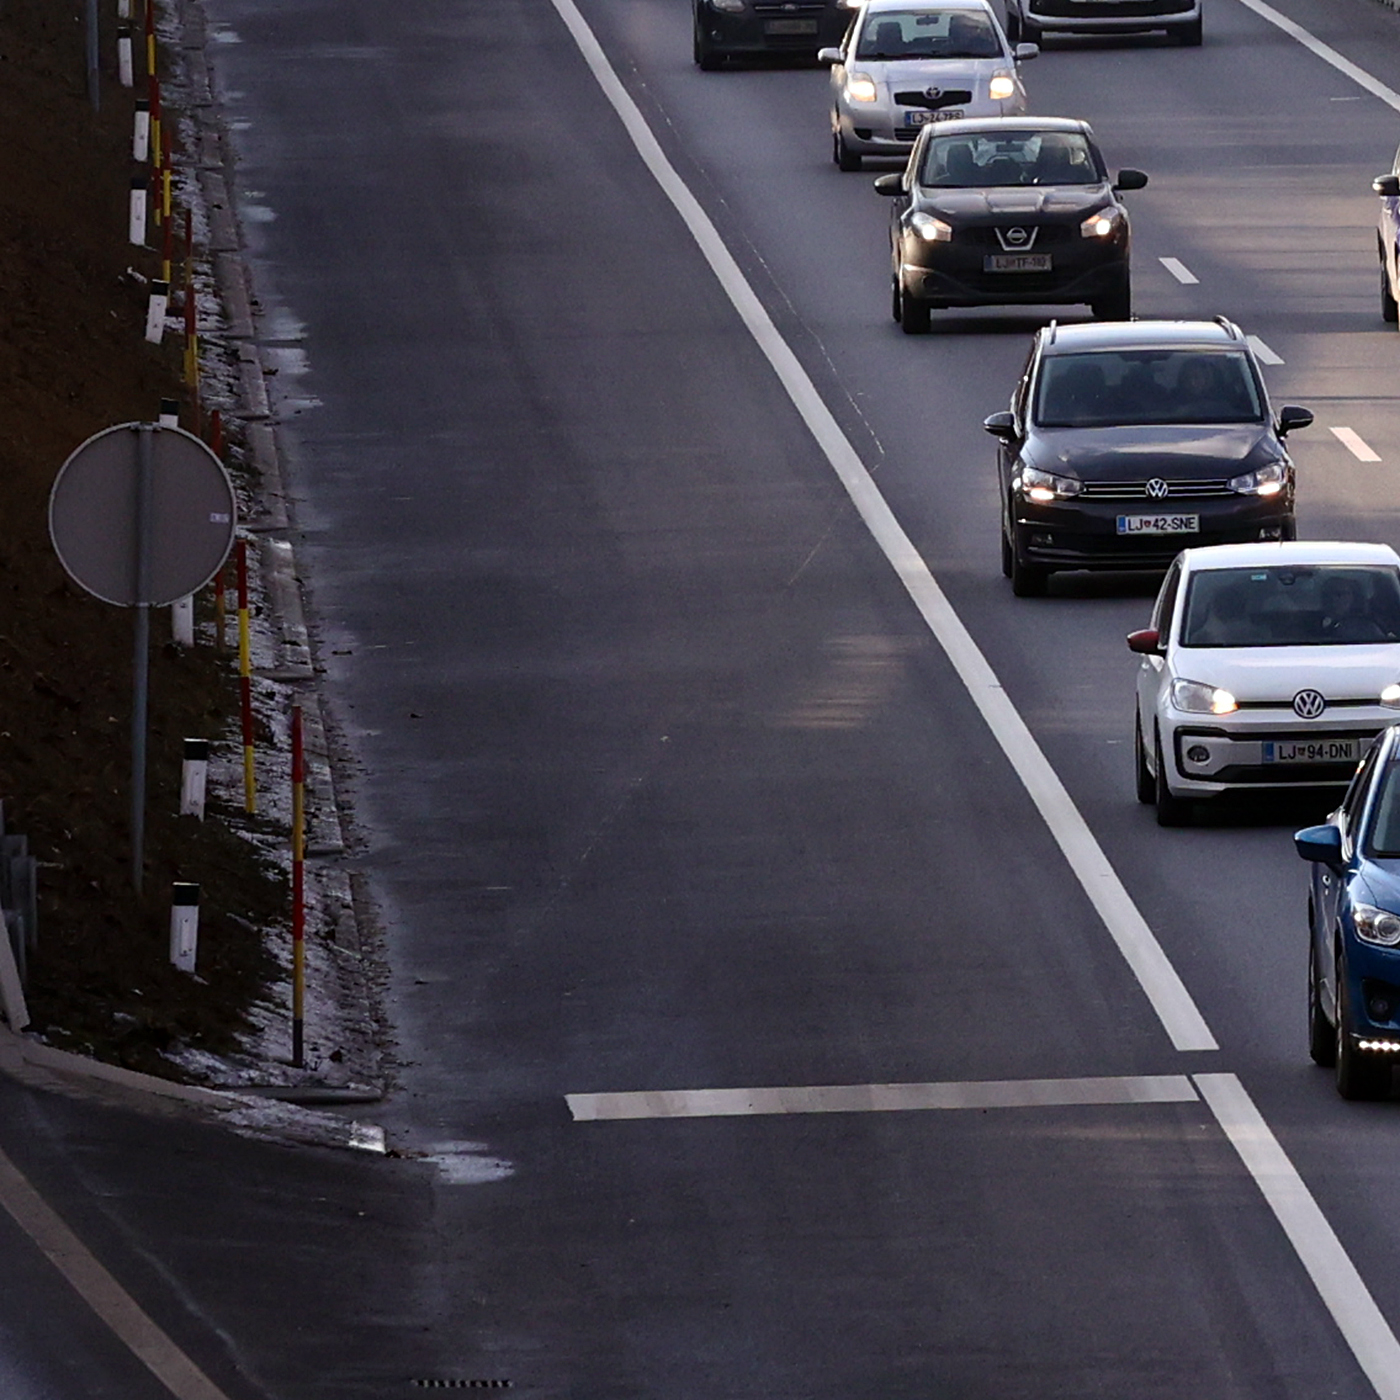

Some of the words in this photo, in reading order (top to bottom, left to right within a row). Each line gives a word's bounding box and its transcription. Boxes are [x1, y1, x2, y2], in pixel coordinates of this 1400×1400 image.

[1127, 518, 1143, 531] LJ
[1152, 516, 1196, 531] 42-SNE
[1278, 745, 1296, 760] LJ
[1307, 743, 1352, 759] 94-DNI
